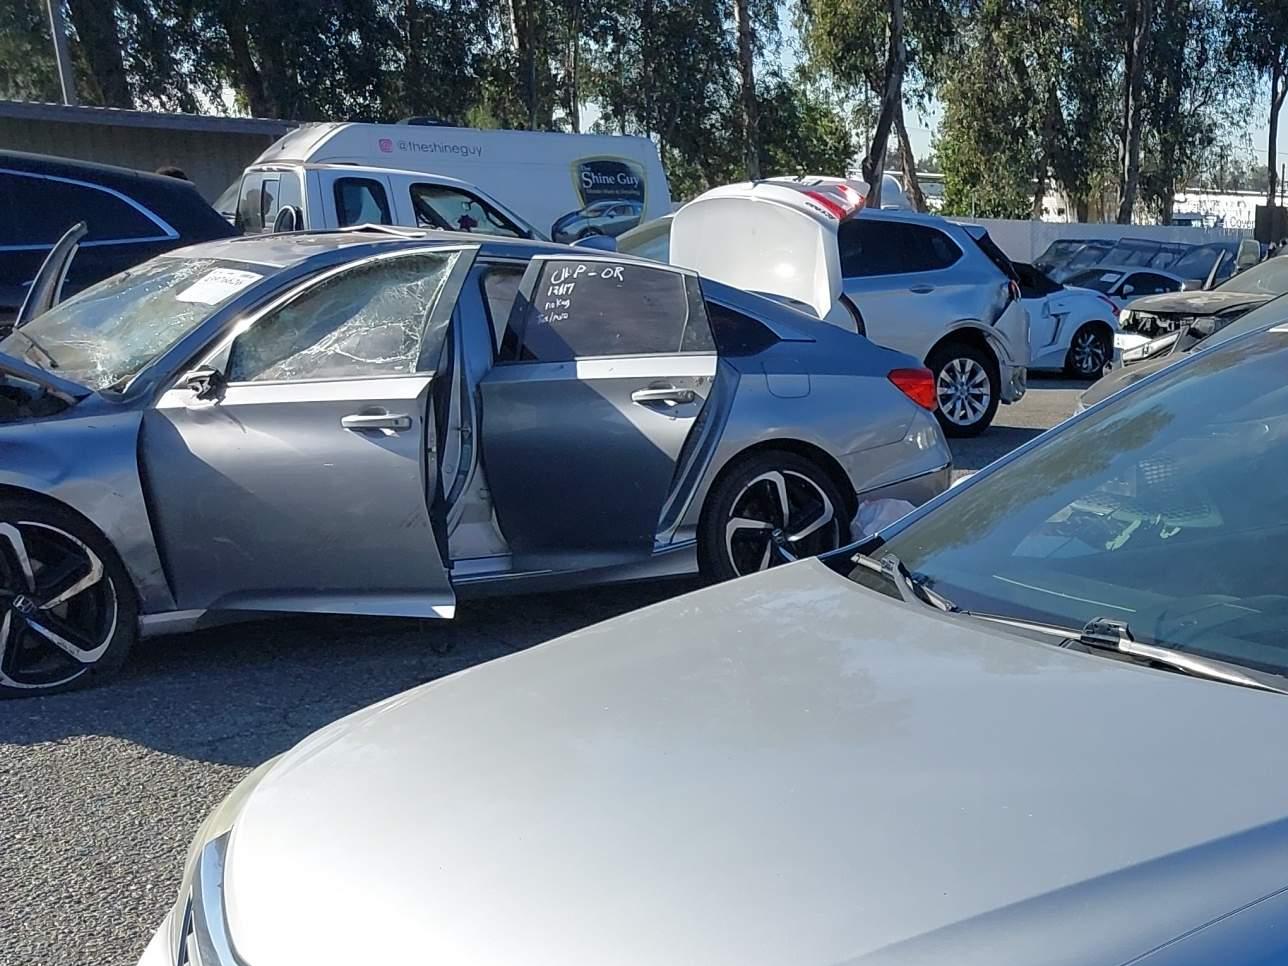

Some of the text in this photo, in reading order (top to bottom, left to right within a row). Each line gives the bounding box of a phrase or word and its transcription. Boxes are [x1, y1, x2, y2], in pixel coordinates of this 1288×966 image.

[399, 141, 483, 158] @theshineguy
[582, 171, 640, 189] Shine Guy
